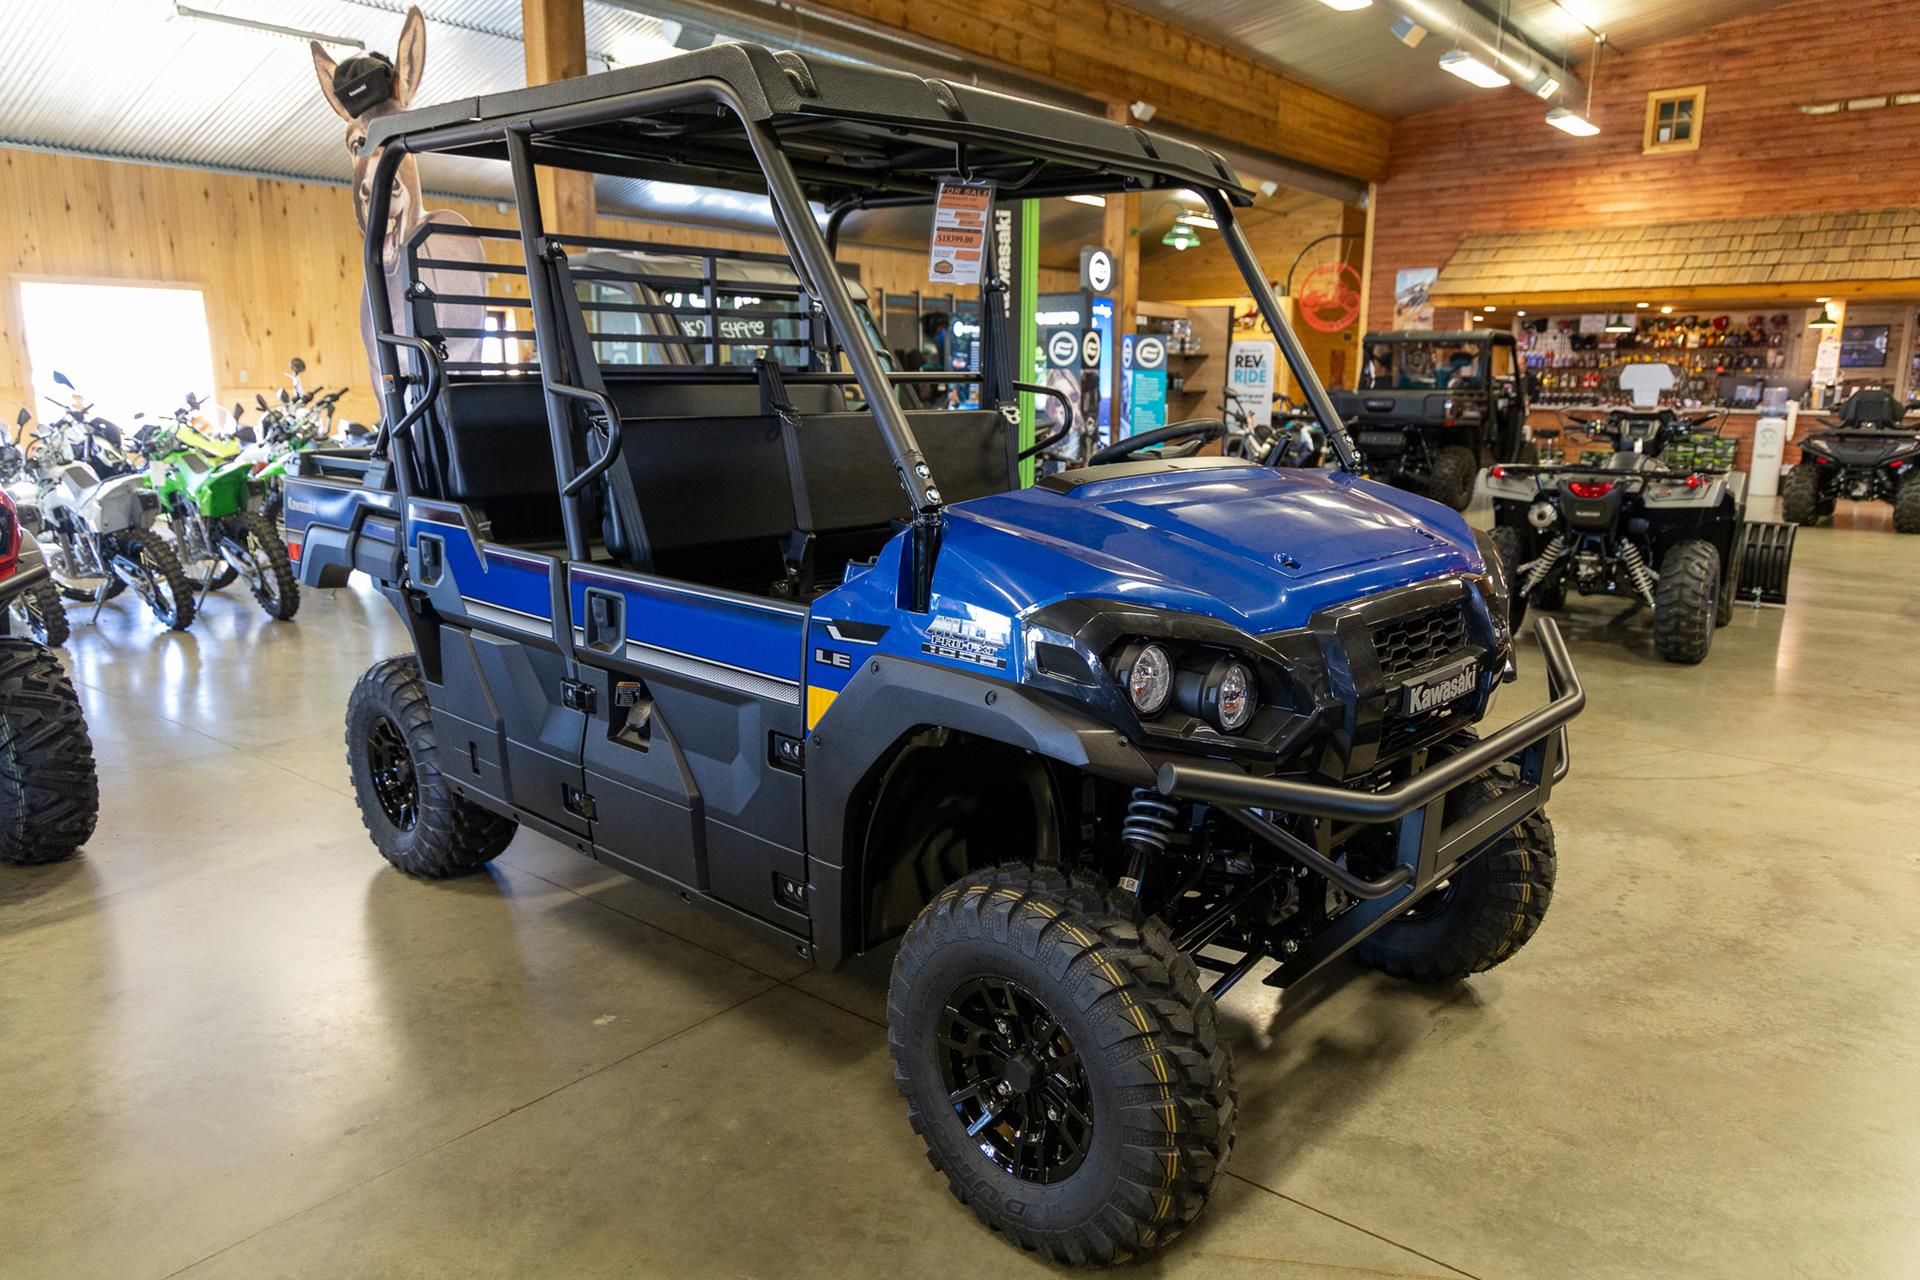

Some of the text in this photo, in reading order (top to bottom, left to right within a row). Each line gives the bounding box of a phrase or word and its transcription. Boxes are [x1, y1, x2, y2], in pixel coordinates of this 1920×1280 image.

[1234, 369, 1267, 383] RIDE
[815, 649, 850, 668] LE
[1409, 664, 1477, 714] Kawasaki
